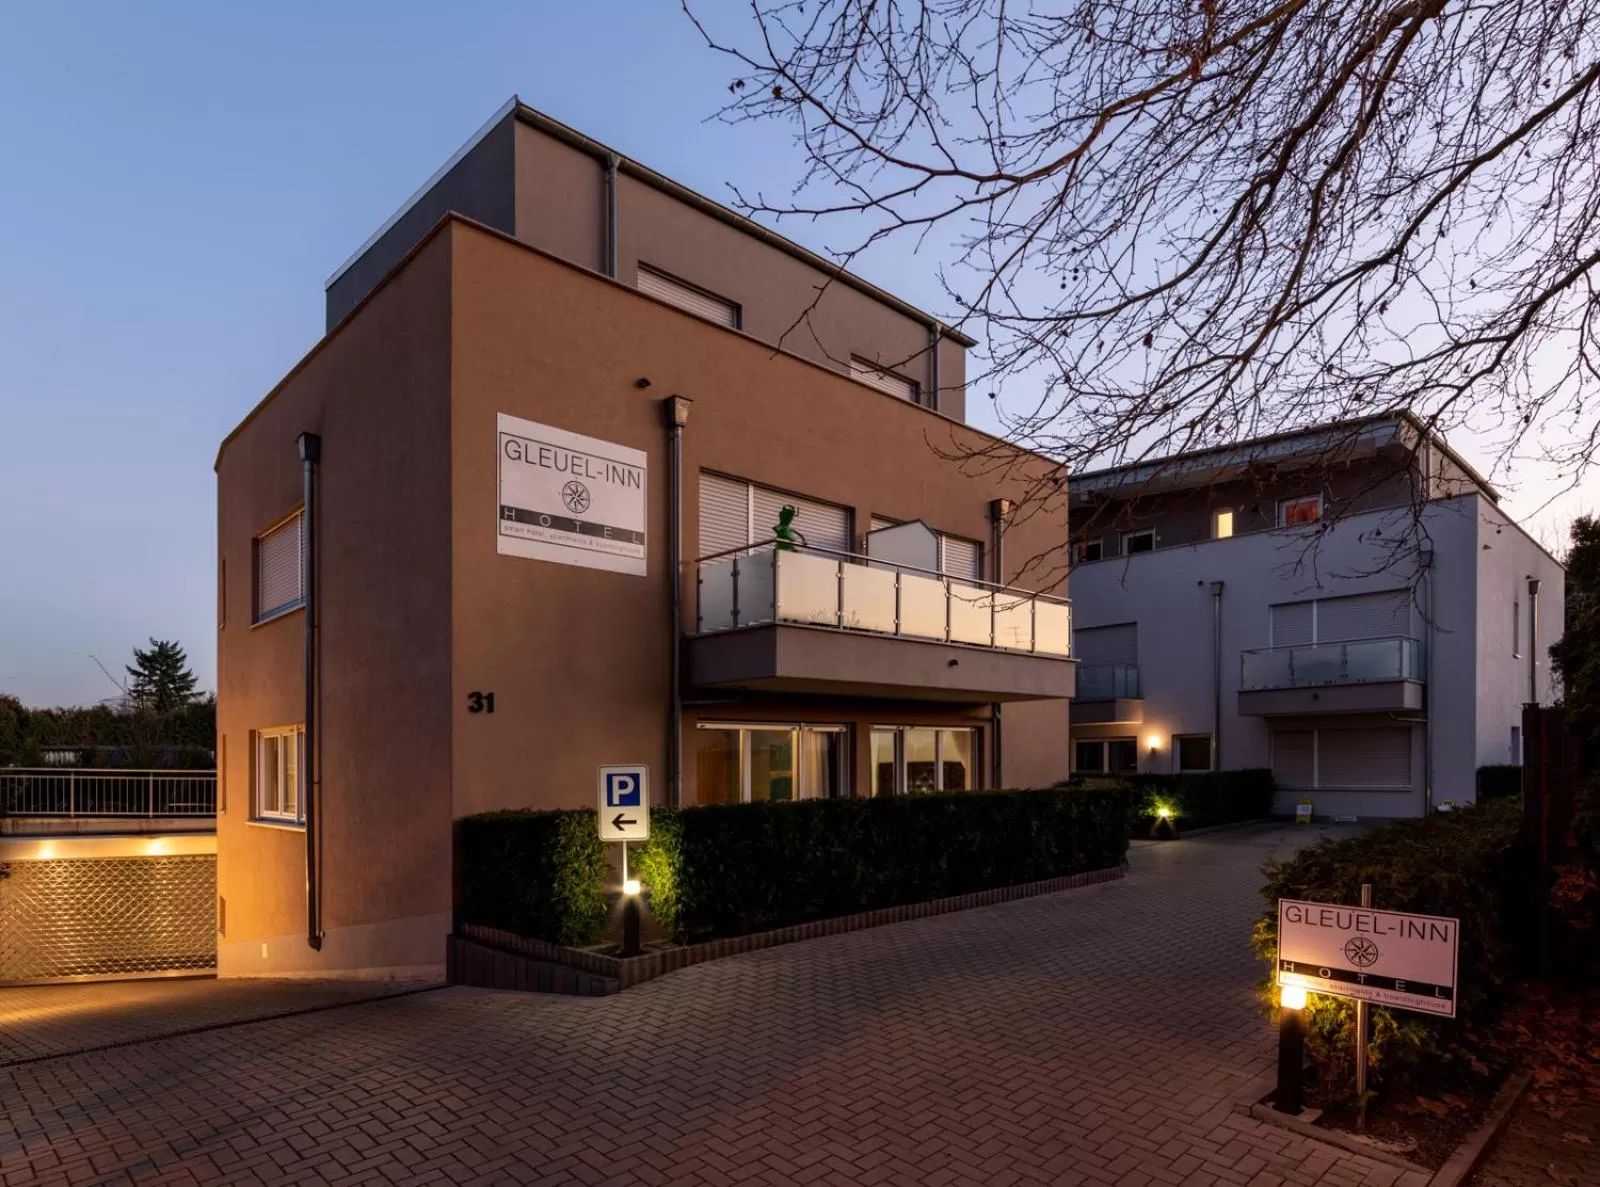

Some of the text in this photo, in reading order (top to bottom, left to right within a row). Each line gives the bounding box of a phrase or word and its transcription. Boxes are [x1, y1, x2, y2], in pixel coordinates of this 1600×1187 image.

[504, 439, 641, 489] GLEUEL-INN
[504, 507, 641, 544] HOTEL
[467, 691, 494, 713] 31
[612, 775, 635, 805] P
[1285, 905, 1449, 943] GLEUEL-INN
[1283, 961, 1446, 999] HOTEL
